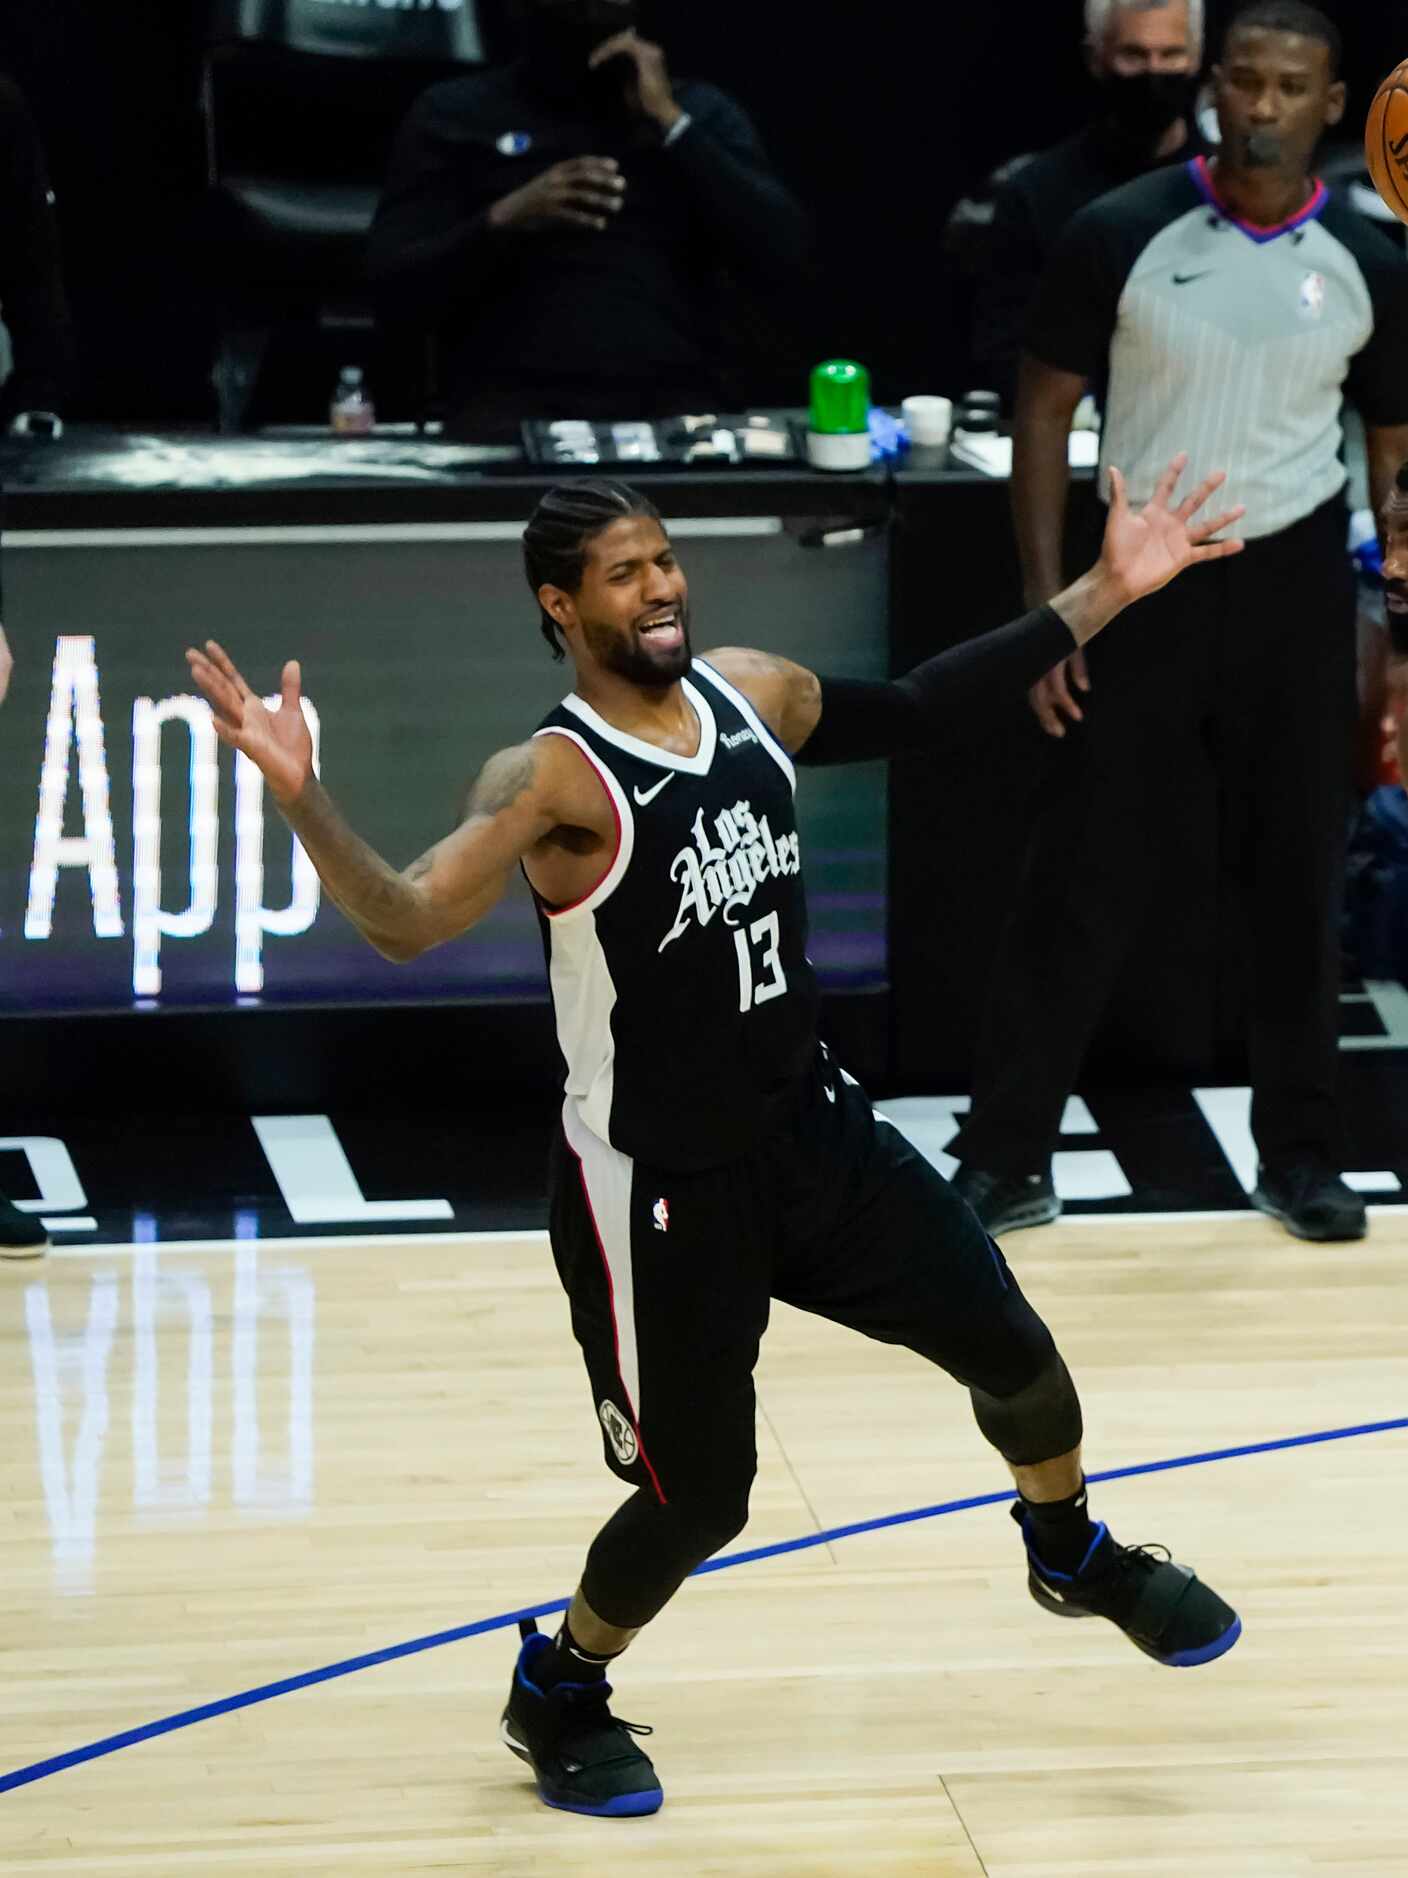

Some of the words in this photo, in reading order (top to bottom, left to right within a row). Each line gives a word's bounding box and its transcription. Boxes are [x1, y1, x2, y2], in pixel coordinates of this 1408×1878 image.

[24, 635, 321, 995] App
[690, 799, 761, 867] Los
[657, 814, 800, 953] Angeles
[733, 911, 787, 1013] 13
